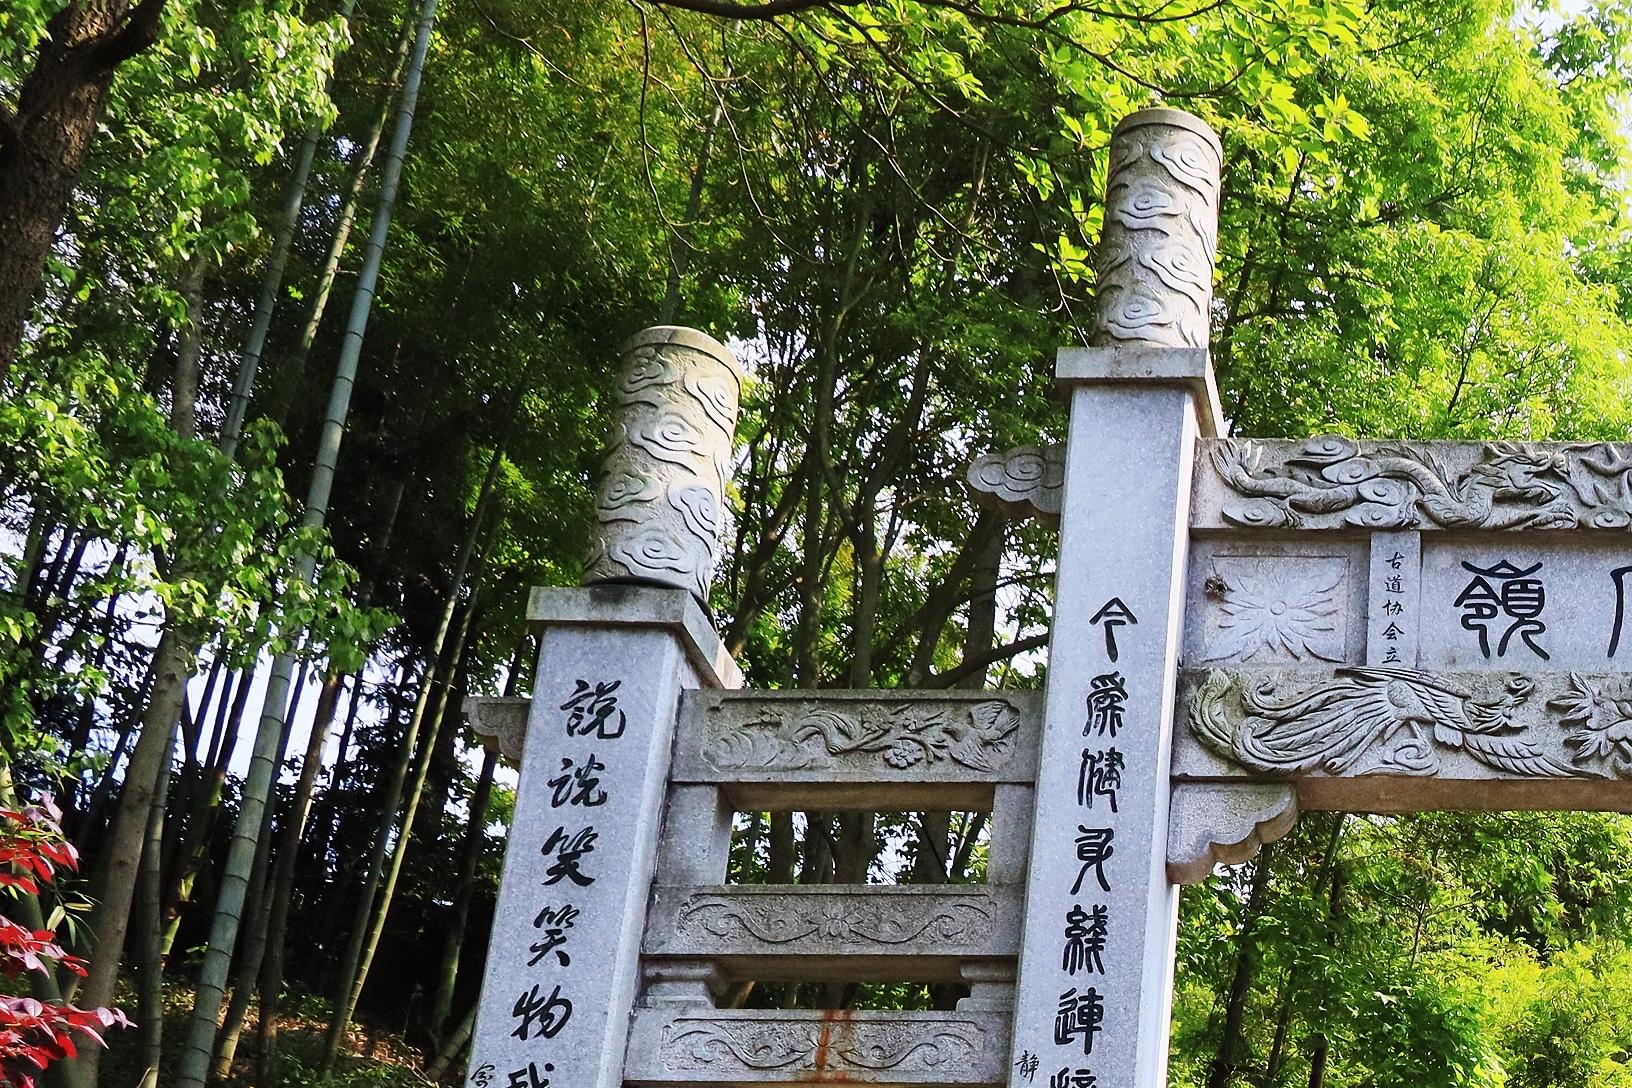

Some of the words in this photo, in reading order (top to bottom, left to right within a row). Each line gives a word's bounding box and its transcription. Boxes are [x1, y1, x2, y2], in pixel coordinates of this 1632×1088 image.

[1382, 551, 1405, 664] 古道协会立
